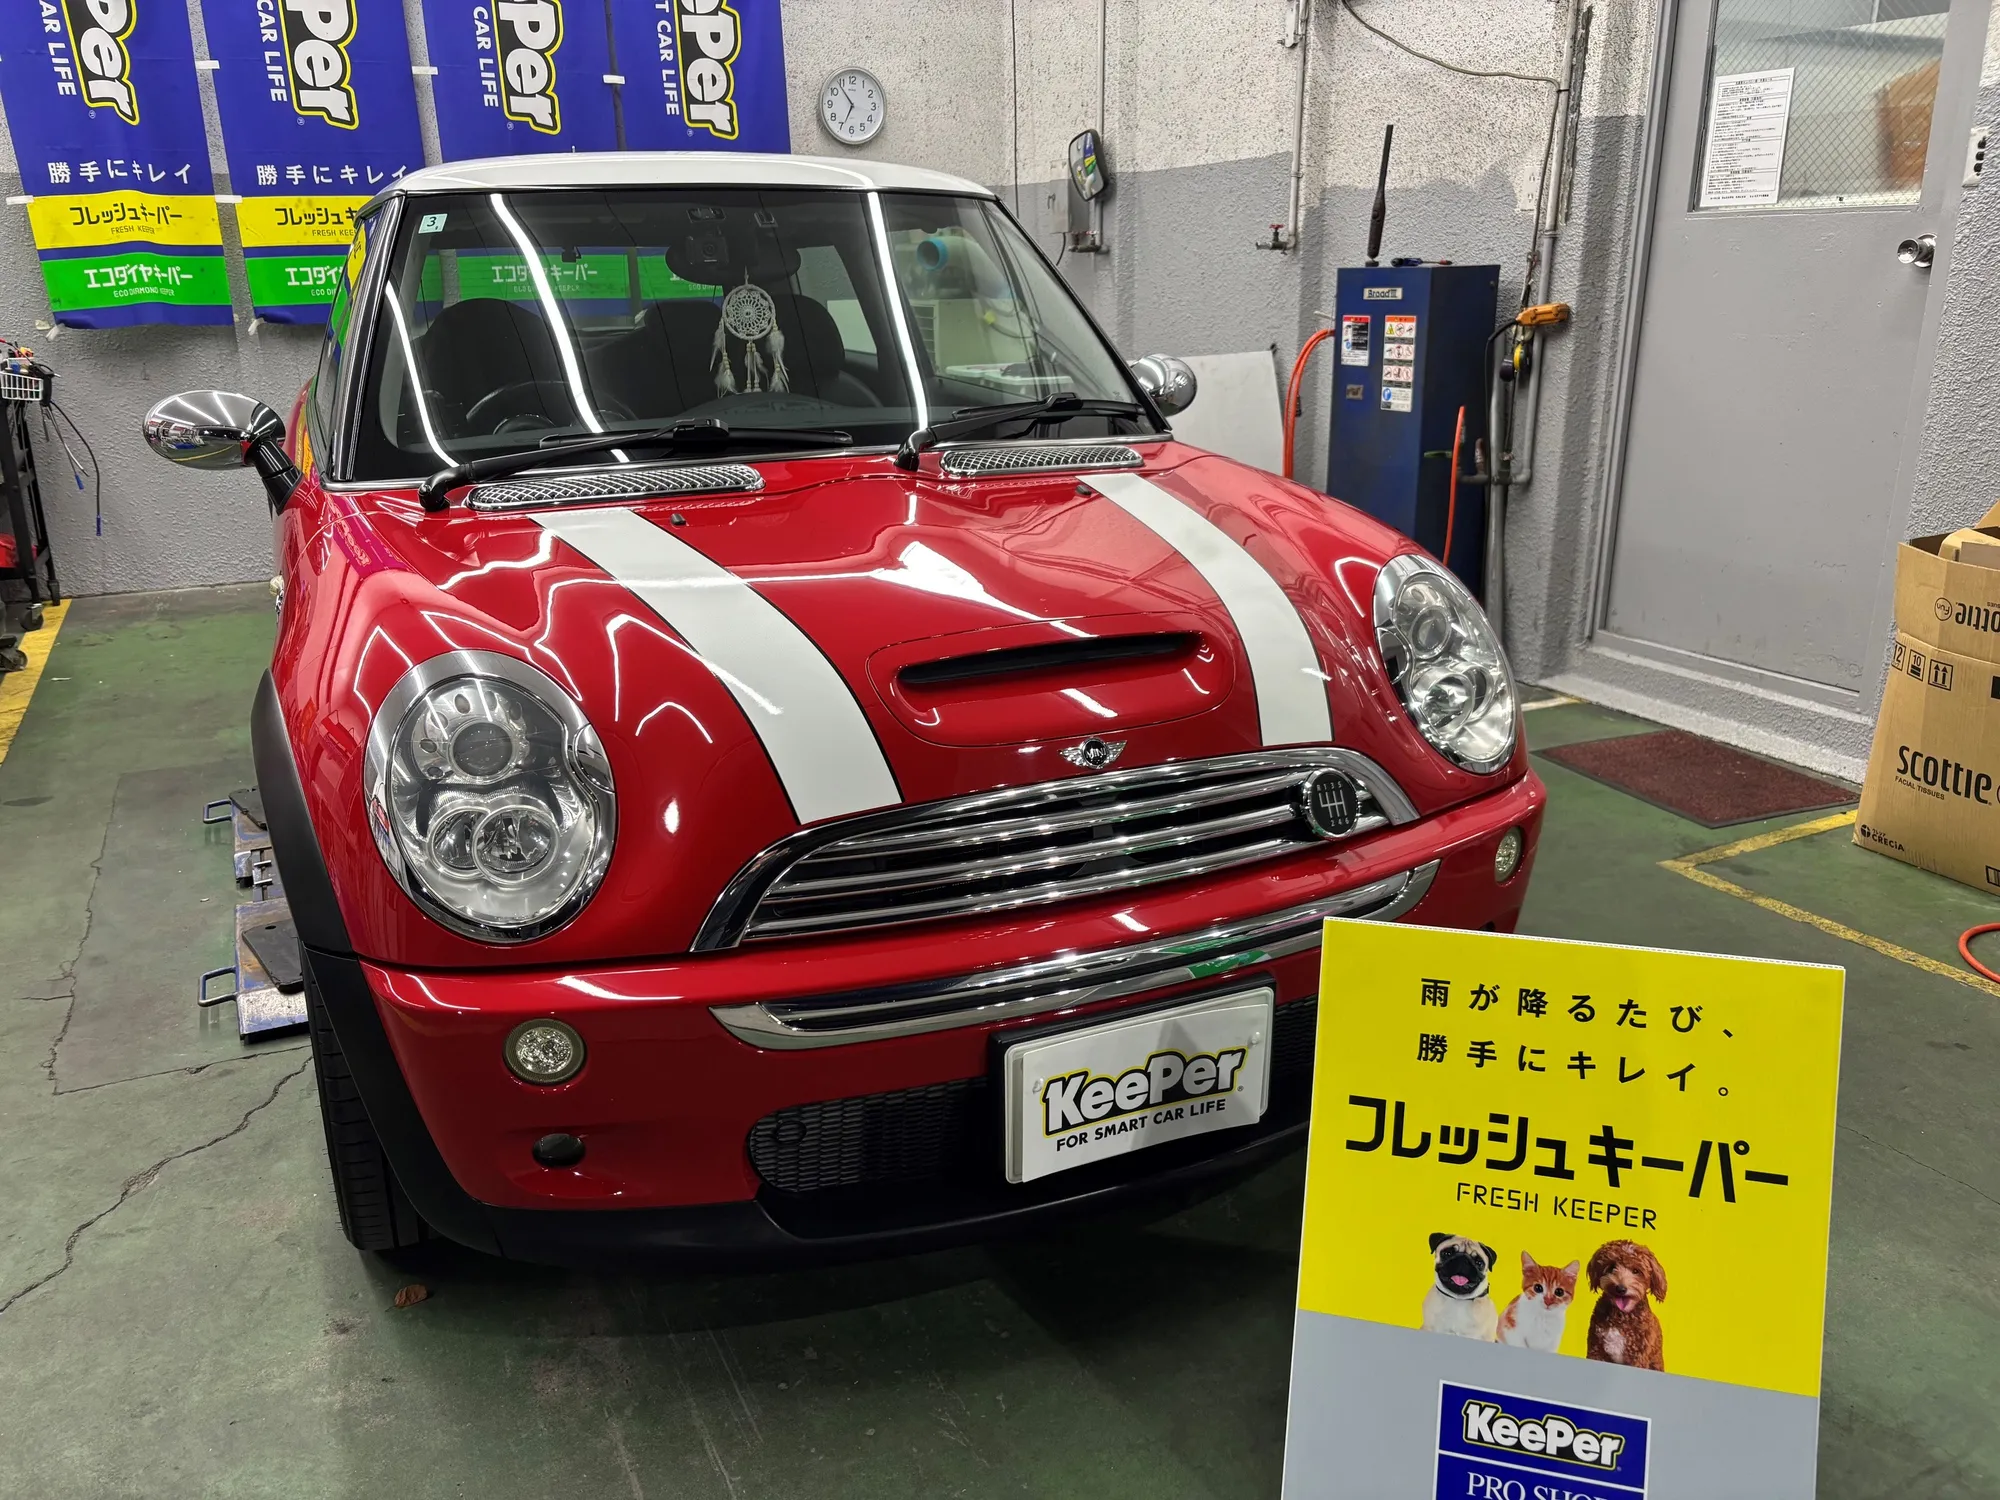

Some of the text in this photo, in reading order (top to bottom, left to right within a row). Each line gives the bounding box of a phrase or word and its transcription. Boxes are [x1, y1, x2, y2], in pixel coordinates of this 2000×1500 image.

[256, 0, 288, 102] CAR LIFE
[656, 20, 674, 62] CAR
[473, 6, 499, 107] CAR LIFE
[48, 42, 77, 96] LIFE
[848, 76, 857, 85] 12
[662, 69, 680, 115] LIFE
[830, 87, 839, 96] 10
[862, 80, 865, 89] 1
[867, 89, 874, 98] 2
[827, 100, 833, 108] 9
[870, 102, 877, 111] 3
[830, 112, 837, 121] 8
[838, 122, 844, 131] 7
[859, 123, 866, 131] 5
[867, 114, 873, 123] 4
[848, 126, 855, 134] 6
[47, 159, 191, 184] 勝手にキレイ
[69, 202, 183, 226] フレッシュキーパー
[426, 216, 437, 227] 3
[110, 225, 135, 235] FRESH
[84, 264, 193, 288] エコダイヤキーパー
[491, 263, 598, 283] エコダキーパー
[113, 290, 129, 298] ECO
[1912, 654, 1922, 667] 10
[1894, 775, 1945, 800] FACIAL TISSUES
[1420, 978, 1735, 1039] 雨が降るたび、
[1416, 1033, 1730, 1097] 勝手にキレイ。
[1042, 1048, 1247, 1135] KeePer
[1056, 1098, 1226, 1152] FOR SMART CAR LIFE
[1345, 1094, 1789, 1204] フレッシュキーパー
[1455, 1182, 1658, 1231] FRESH KEEPER
[1464, 1402, 1622, 1466] KeePer
[1465, 1471, 1527, 1500] PRO
